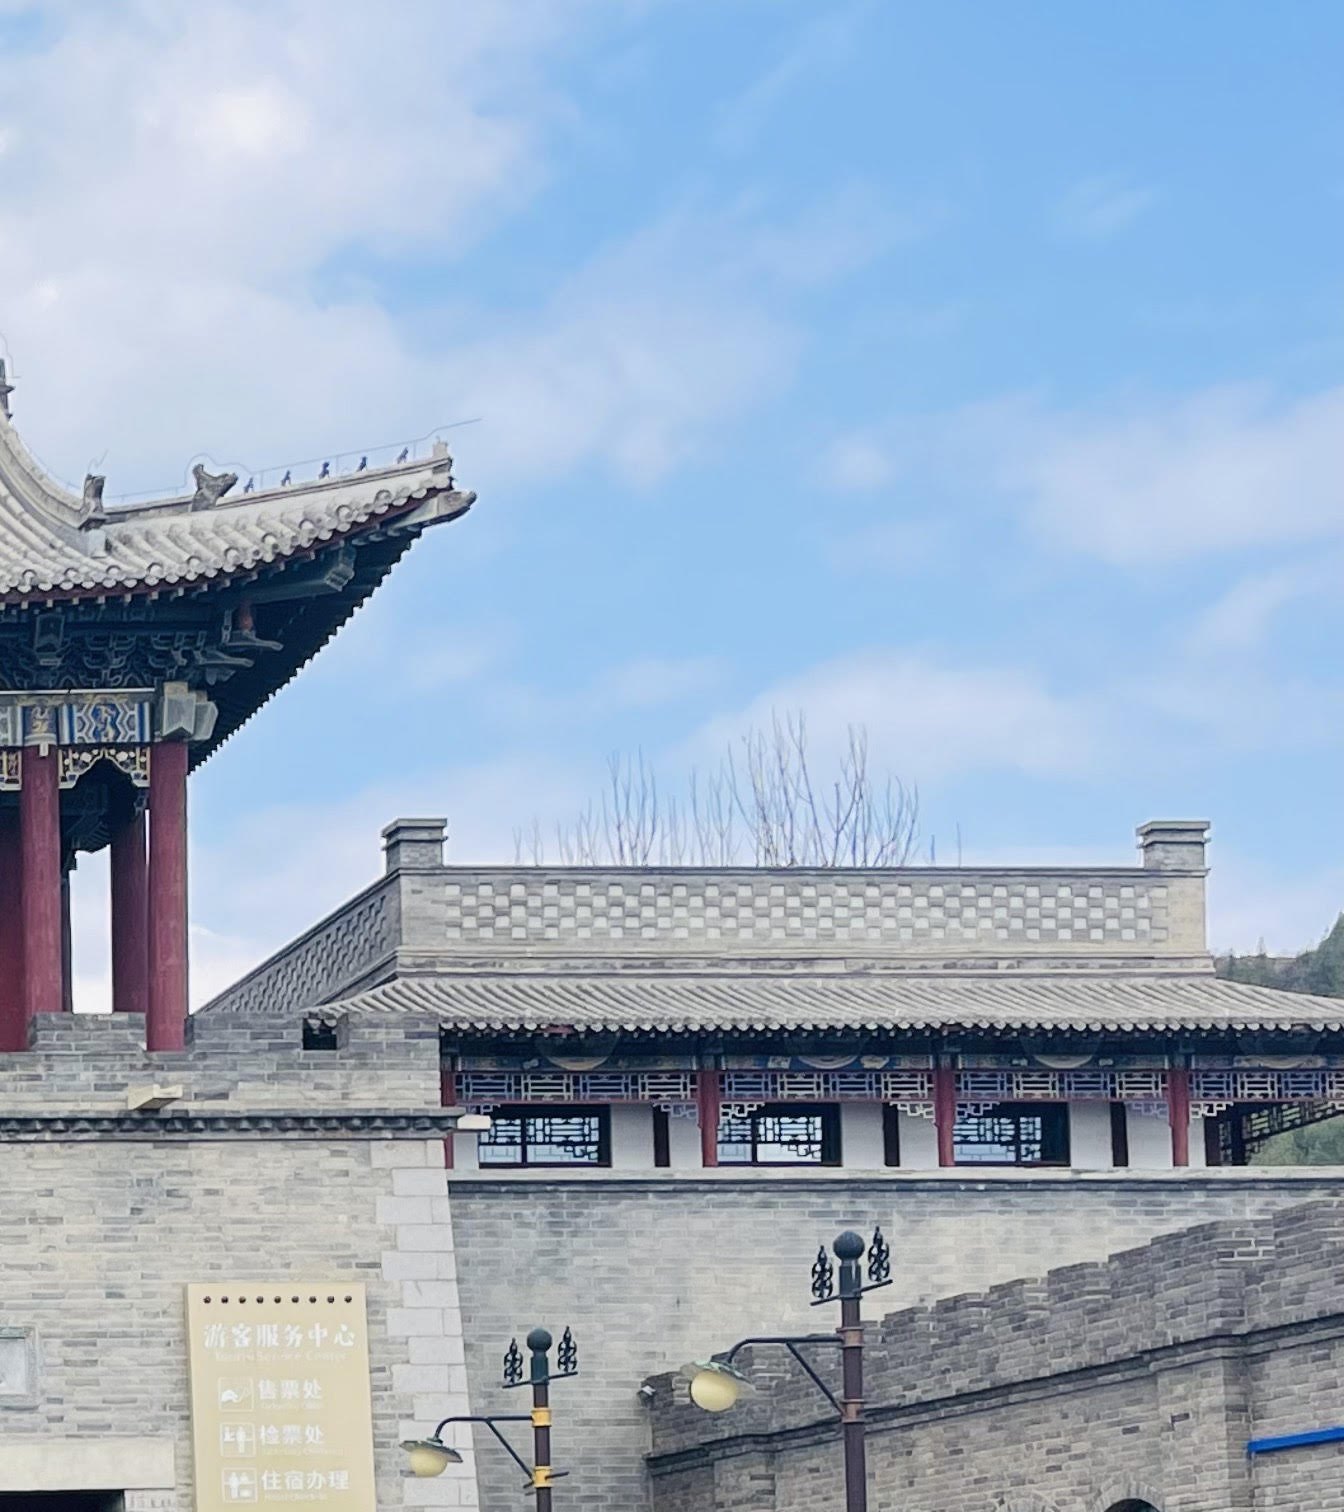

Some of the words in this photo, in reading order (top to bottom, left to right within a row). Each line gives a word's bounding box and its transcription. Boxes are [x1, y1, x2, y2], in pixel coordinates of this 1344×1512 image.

[204, 1322, 355, 1348] 游客服务中心
[258, 1379, 322, 1399] 售票处
[260, 1424, 325, 1445] 检票处
[262, 1470, 350, 1490] 住宿办理
